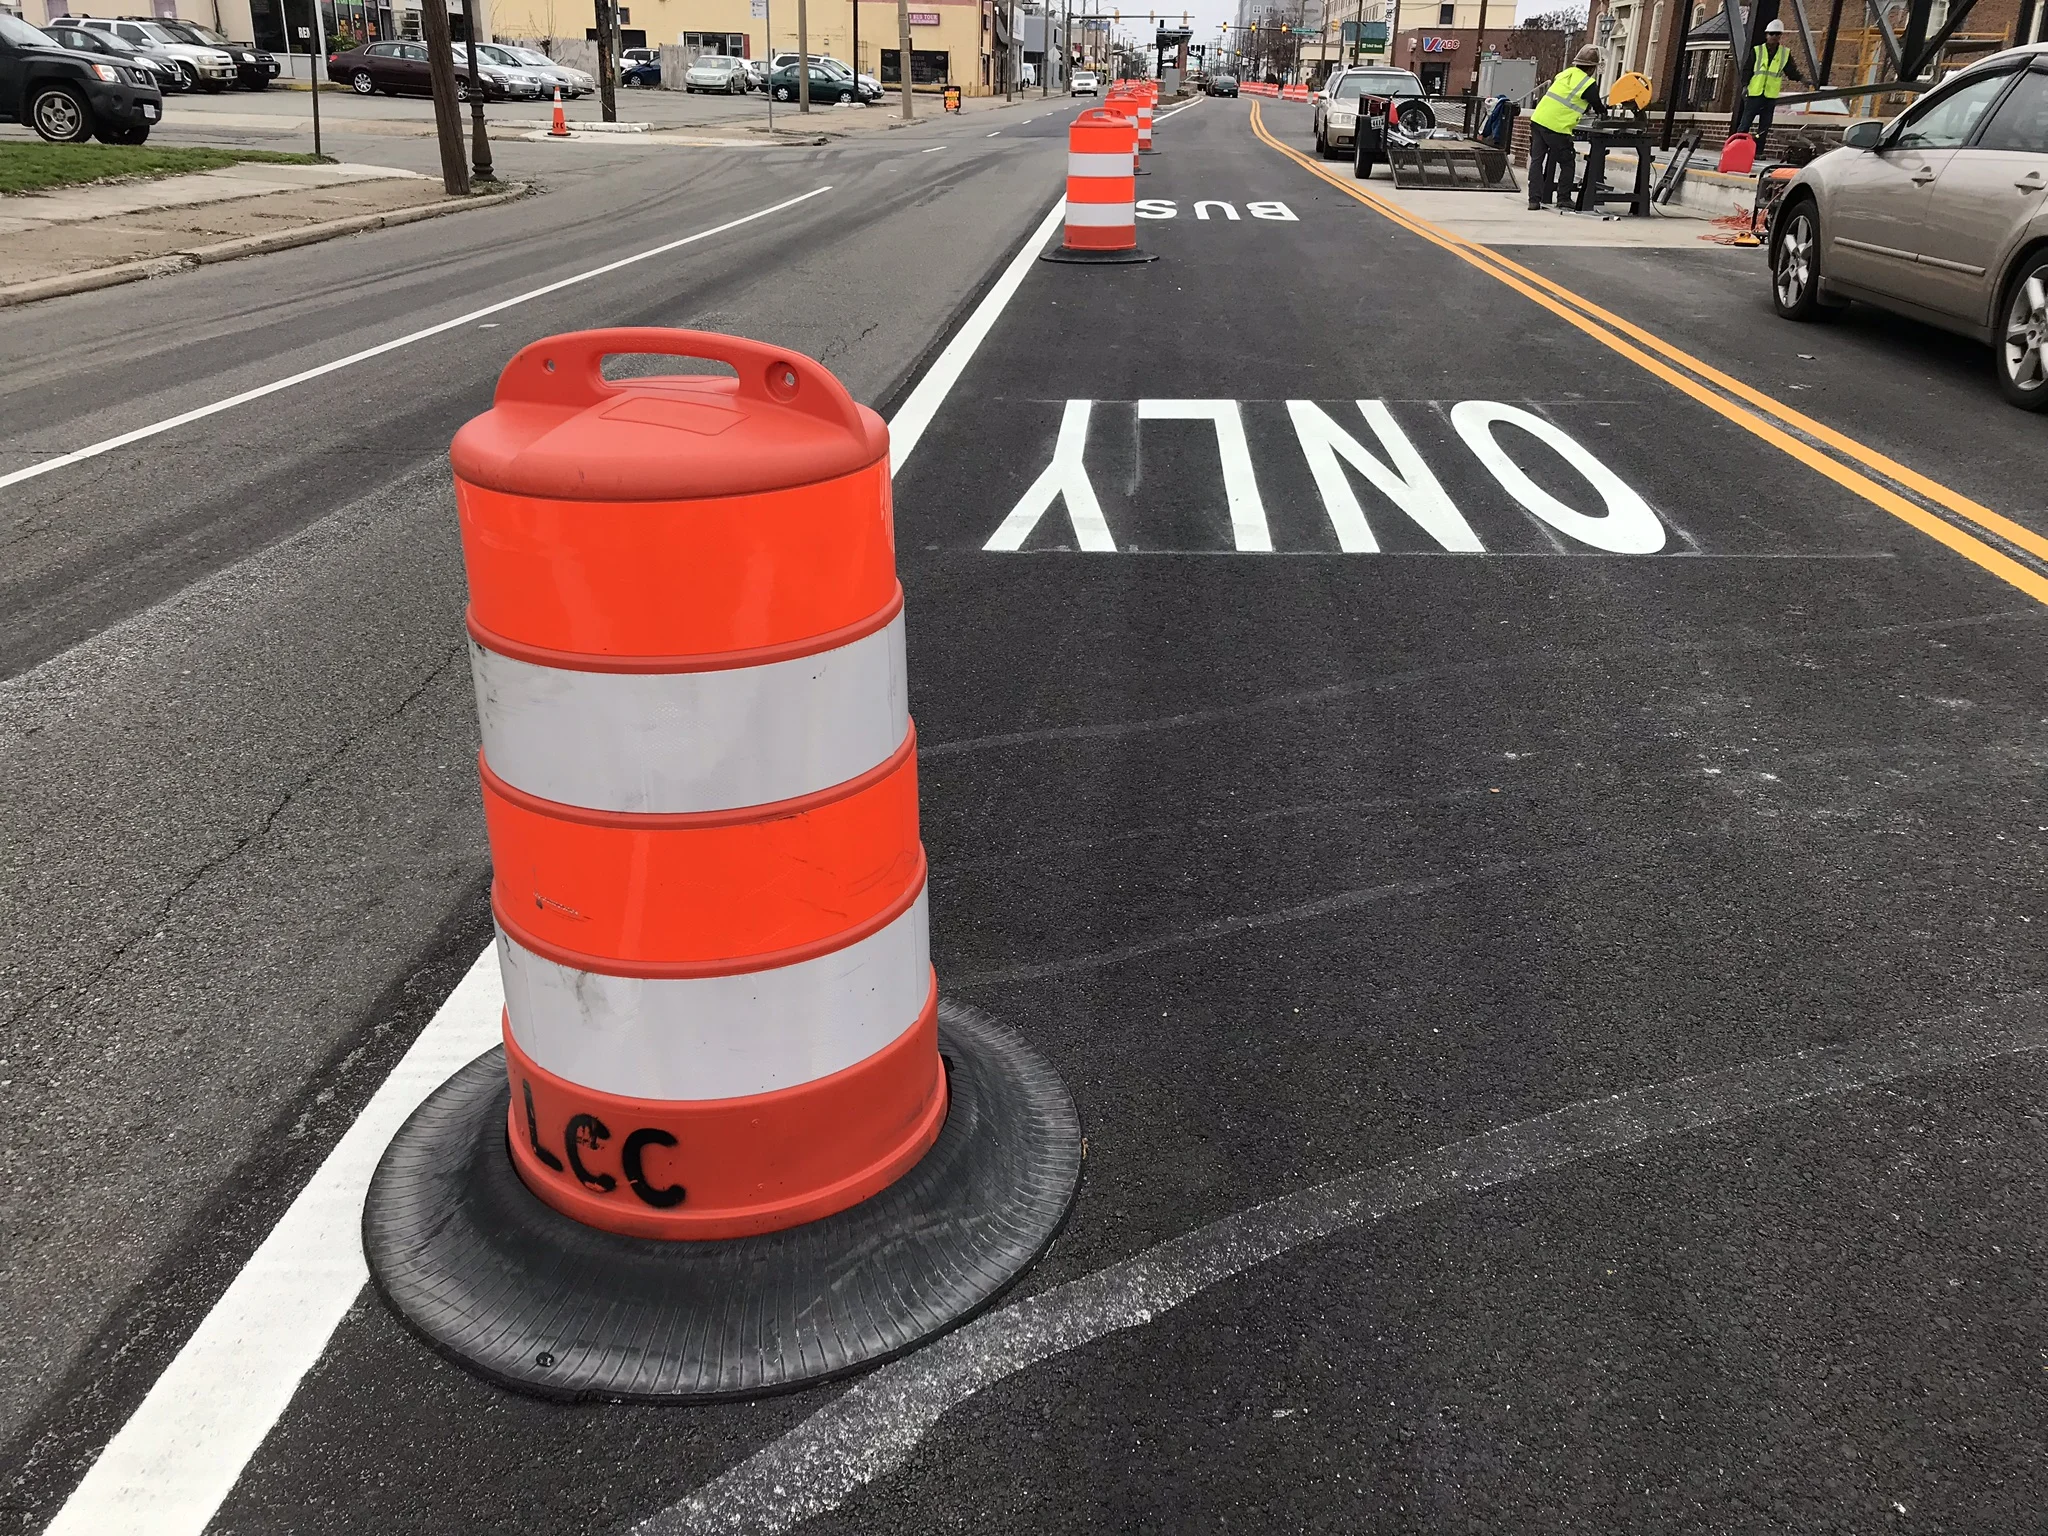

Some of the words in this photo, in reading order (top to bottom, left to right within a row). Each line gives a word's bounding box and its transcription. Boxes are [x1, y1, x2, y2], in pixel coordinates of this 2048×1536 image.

[298, 27, 311, 38] REN
[1440, 39, 1460, 50] ABC
[1134, 199, 1300, 221] BUS
[981, 399, 1666, 554] ONLY
[523, 1078, 686, 1210] LCC
